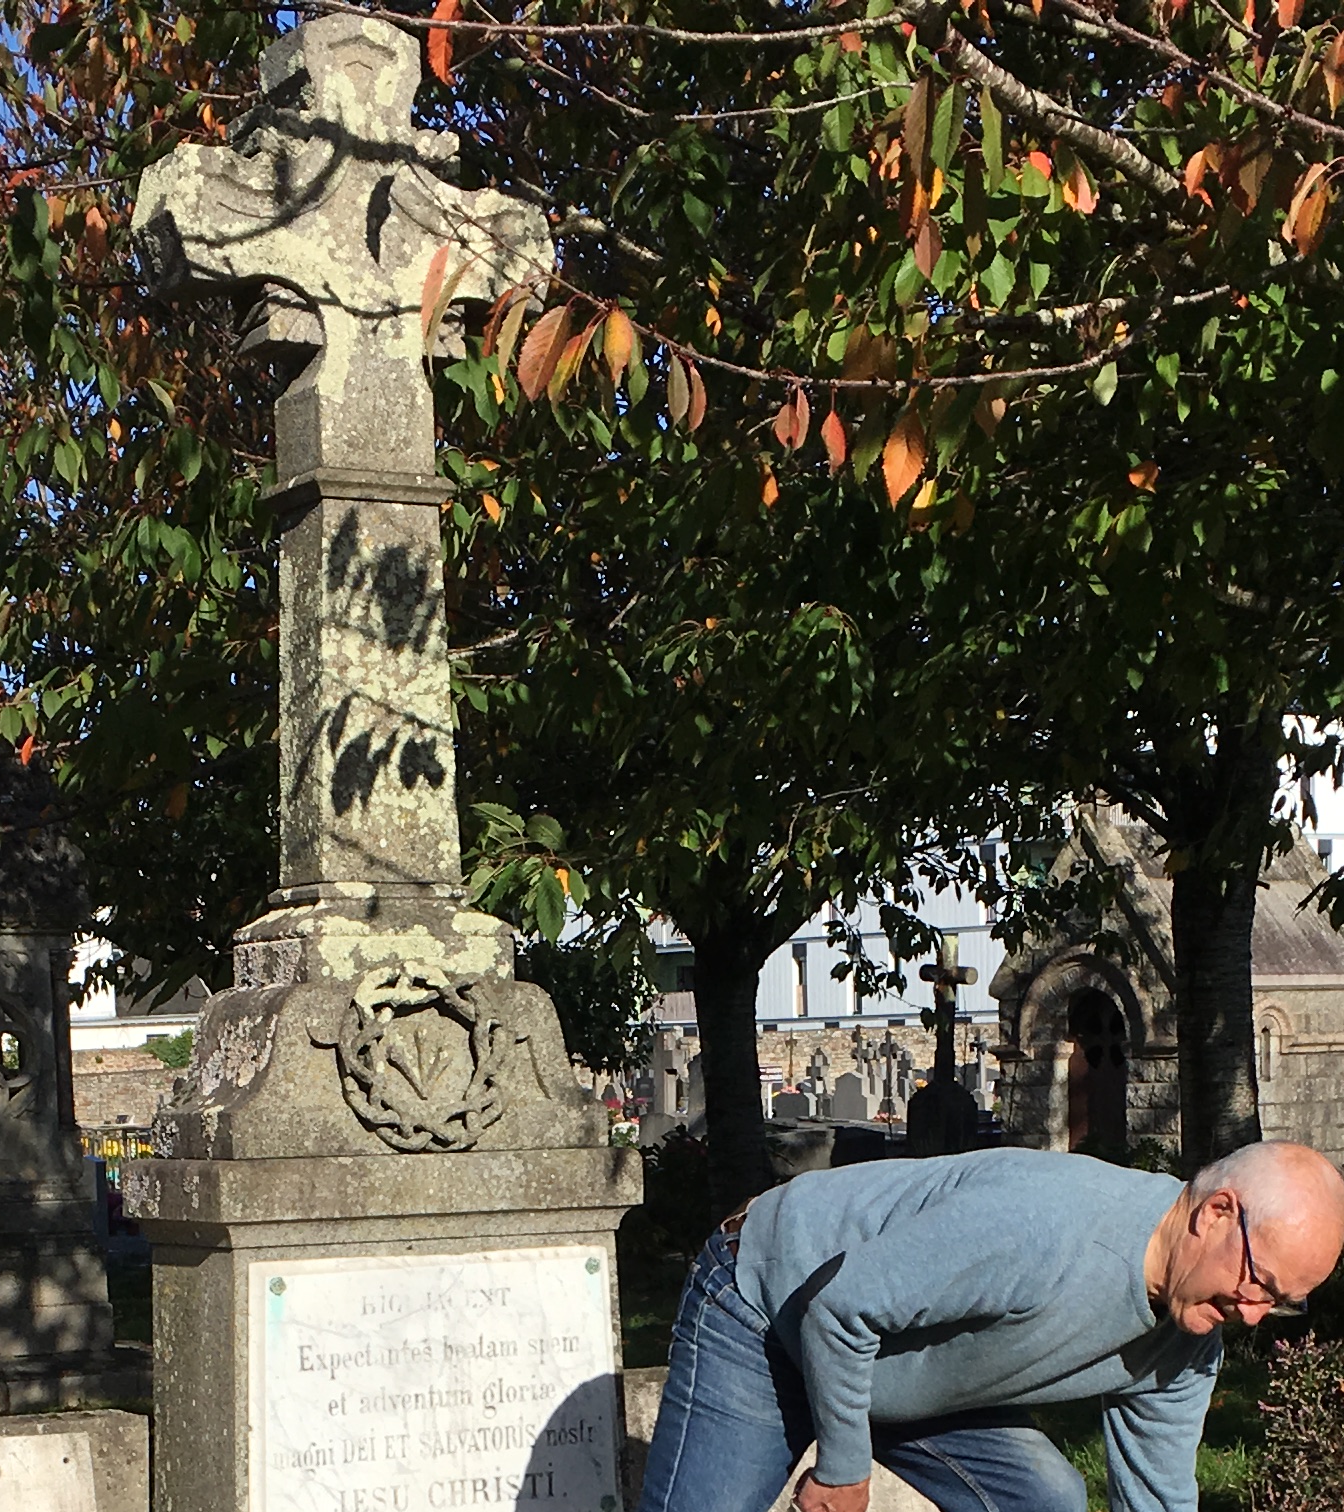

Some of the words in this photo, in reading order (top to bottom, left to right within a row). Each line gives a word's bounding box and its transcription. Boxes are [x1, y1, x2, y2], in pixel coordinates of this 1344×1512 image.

[328, 1391, 348, 1417] et
[385, 1433, 412, 1460] ET
[419, 1418, 537, 1457] SALVATORIS
